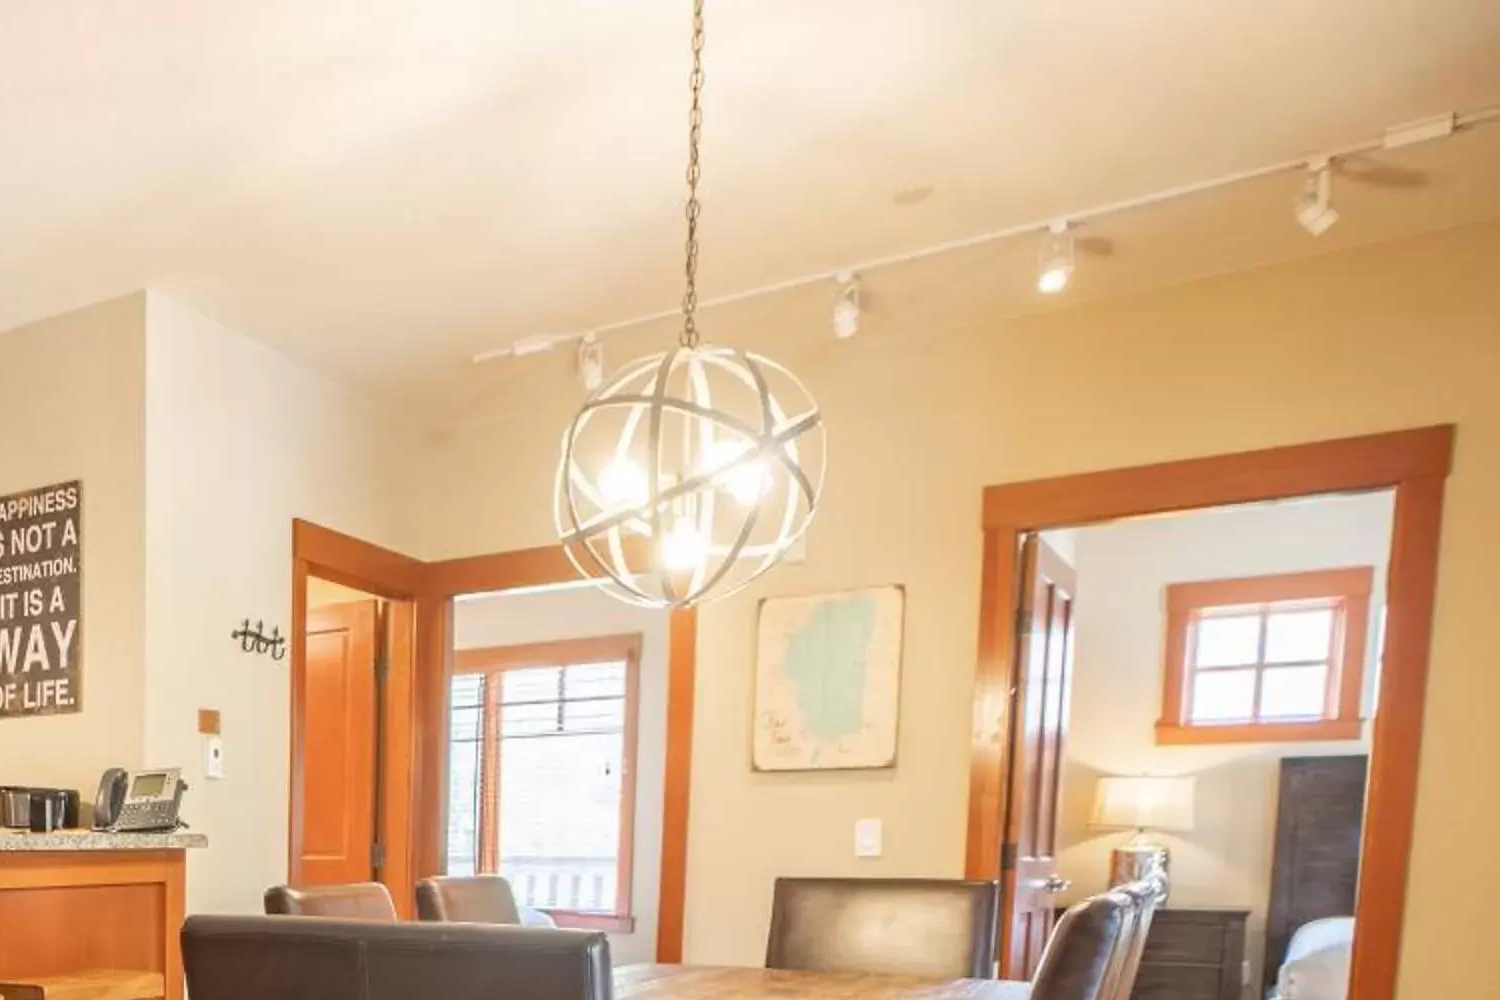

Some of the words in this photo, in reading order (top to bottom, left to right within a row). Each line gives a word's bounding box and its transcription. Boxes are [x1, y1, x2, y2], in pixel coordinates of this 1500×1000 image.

[11, 523, 56, 555] NOT
[61, 520, 77, 545] A
[0, 594, 18, 619] IT
[24, 589, 42, 615] IS
[50, 587, 65, 612] A
[24, 680, 74, 708] LIFE.
